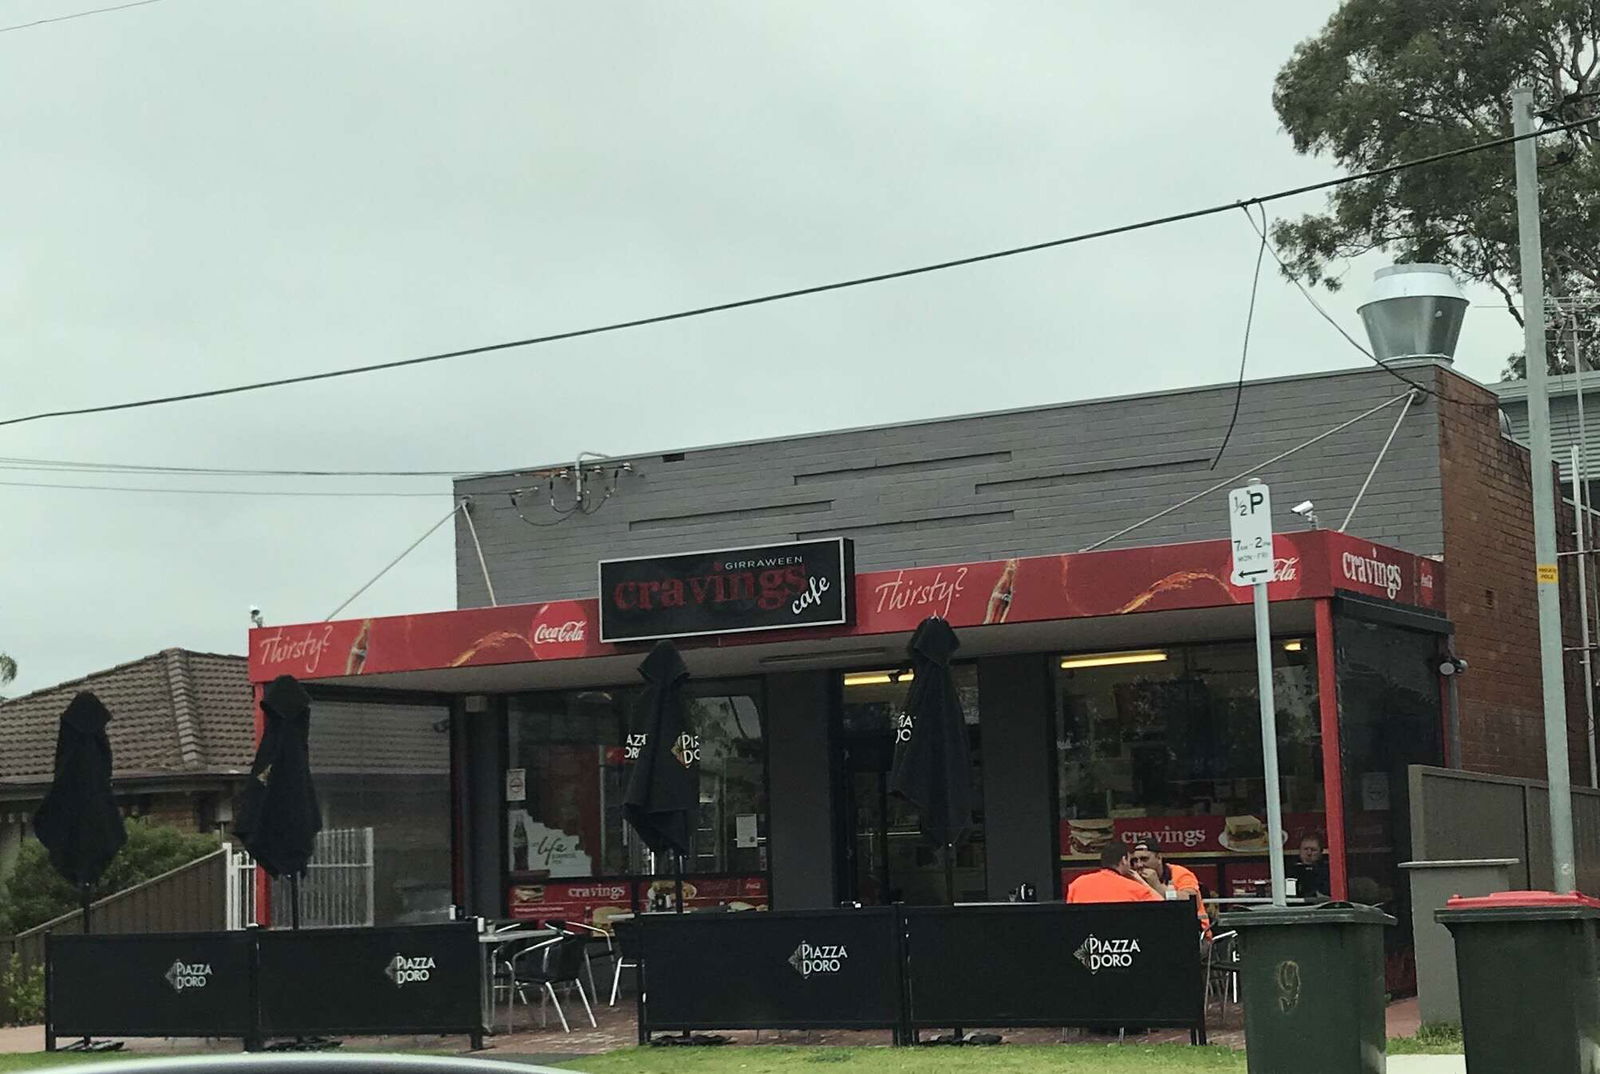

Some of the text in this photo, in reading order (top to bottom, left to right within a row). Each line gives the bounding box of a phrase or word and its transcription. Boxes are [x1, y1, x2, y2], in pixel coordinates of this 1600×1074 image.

[724, 555, 803, 571] GIRRAWEEN
[1342, 547, 1402, 600] cravings
[614, 562, 807, 612] cravings
[791, 575, 831, 615] cafe
[875, 567, 968, 619] Thirsty?
[260, 625, 334, 673] Thirsty?
[1121, 825, 1206, 847] cravings
[568, 883, 625, 900] cravings
[802, 944, 848, 960] PIAZZA
[1089, 937, 1141, 954] PIAZZA
[176, 961, 213, 976] PIAZZA
[396, 955, 436, 970] PIAZZA
